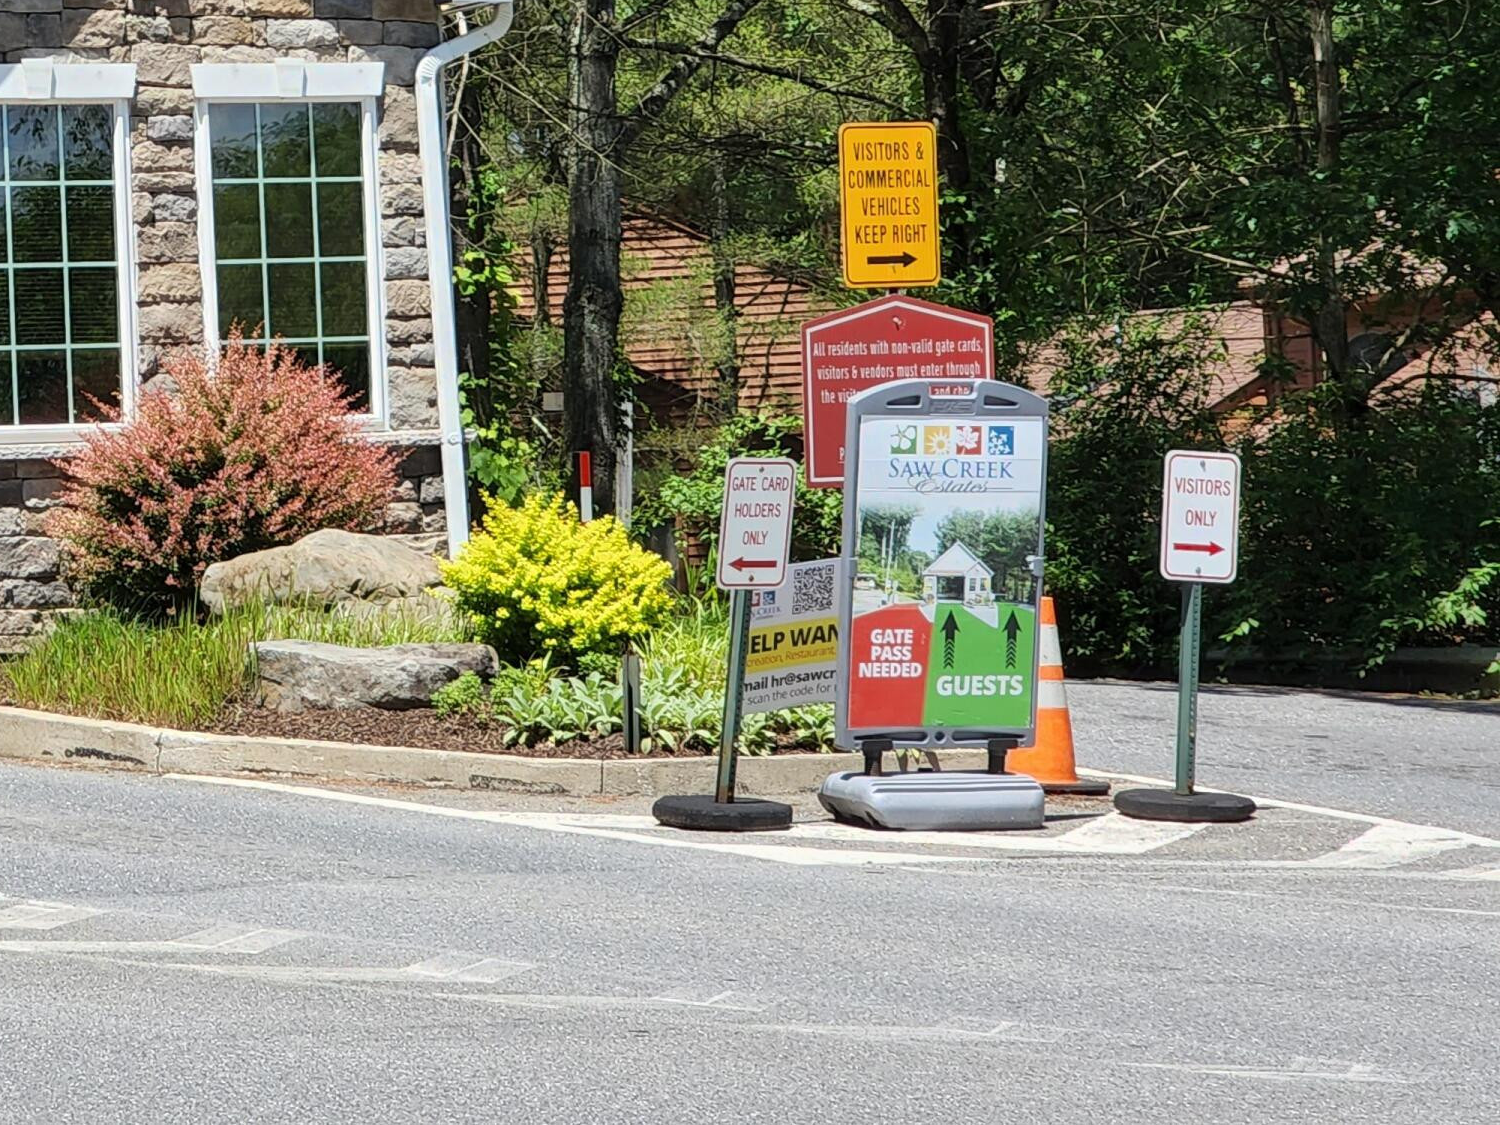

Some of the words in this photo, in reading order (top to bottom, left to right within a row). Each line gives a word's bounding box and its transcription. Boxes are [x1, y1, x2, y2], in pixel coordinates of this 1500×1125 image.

[853, 141, 909, 161] VISITORS
[915, 141, 924, 160] &
[848, 169, 930, 189] COMMERCIAL
[861, 197, 920, 216] VEHICLES
[855, 225, 887, 244] KEEP
[892, 224, 927, 243] RIGHT
[813, 341, 826, 356] All
[828, 340, 868, 356] residents
[870, 340, 889, 355] with
[891, 339, 933, 355] non-valid
[935, 341, 955, 356] gate
[957, 338, 984, 354] cards,
[817, 365, 849, 380] visitors
[851, 366, 858, 379] &
[860, 363, 894, 379] vendors
[897, 364, 918, 378] must
[920, 363, 944, 377] enter
[946, 361, 981, 378] through
[821, 388, 836, 403] the
[888, 458, 937, 478] SAW
[941, 458, 1014, 478] CREEK
[732, 477, 757, 491] GATE
[762, 477, 789, 491] CARD
[907, 473, 988, 494] Estates
[1174, 477, 1231, 496] VISITORS
[734, 503, 781, 518] HOLDERS
[1185, 509, 1217, 527] ONLY
[742, 530, 768, 545] ONLY
[750, 631, 786, 654] ELP
[790, 624, 838, 647] WAN
[870, 628, 914, 644] GATE
[747, 655, 783, 668] creation,
[870, 646, 912, 661] PASS
[858, 662, 923, 678] NEEDED
[743, 676, 768, 692] mail
[771, 670, 836, 688] hr@sawcr
[936, 675, 1024, 696] GUESTS
[747, 693, 770, 706] scan
[772, 690, 788, 701] the
[789, 685, 813, 698] code
[815, 683, 832, 694] for
